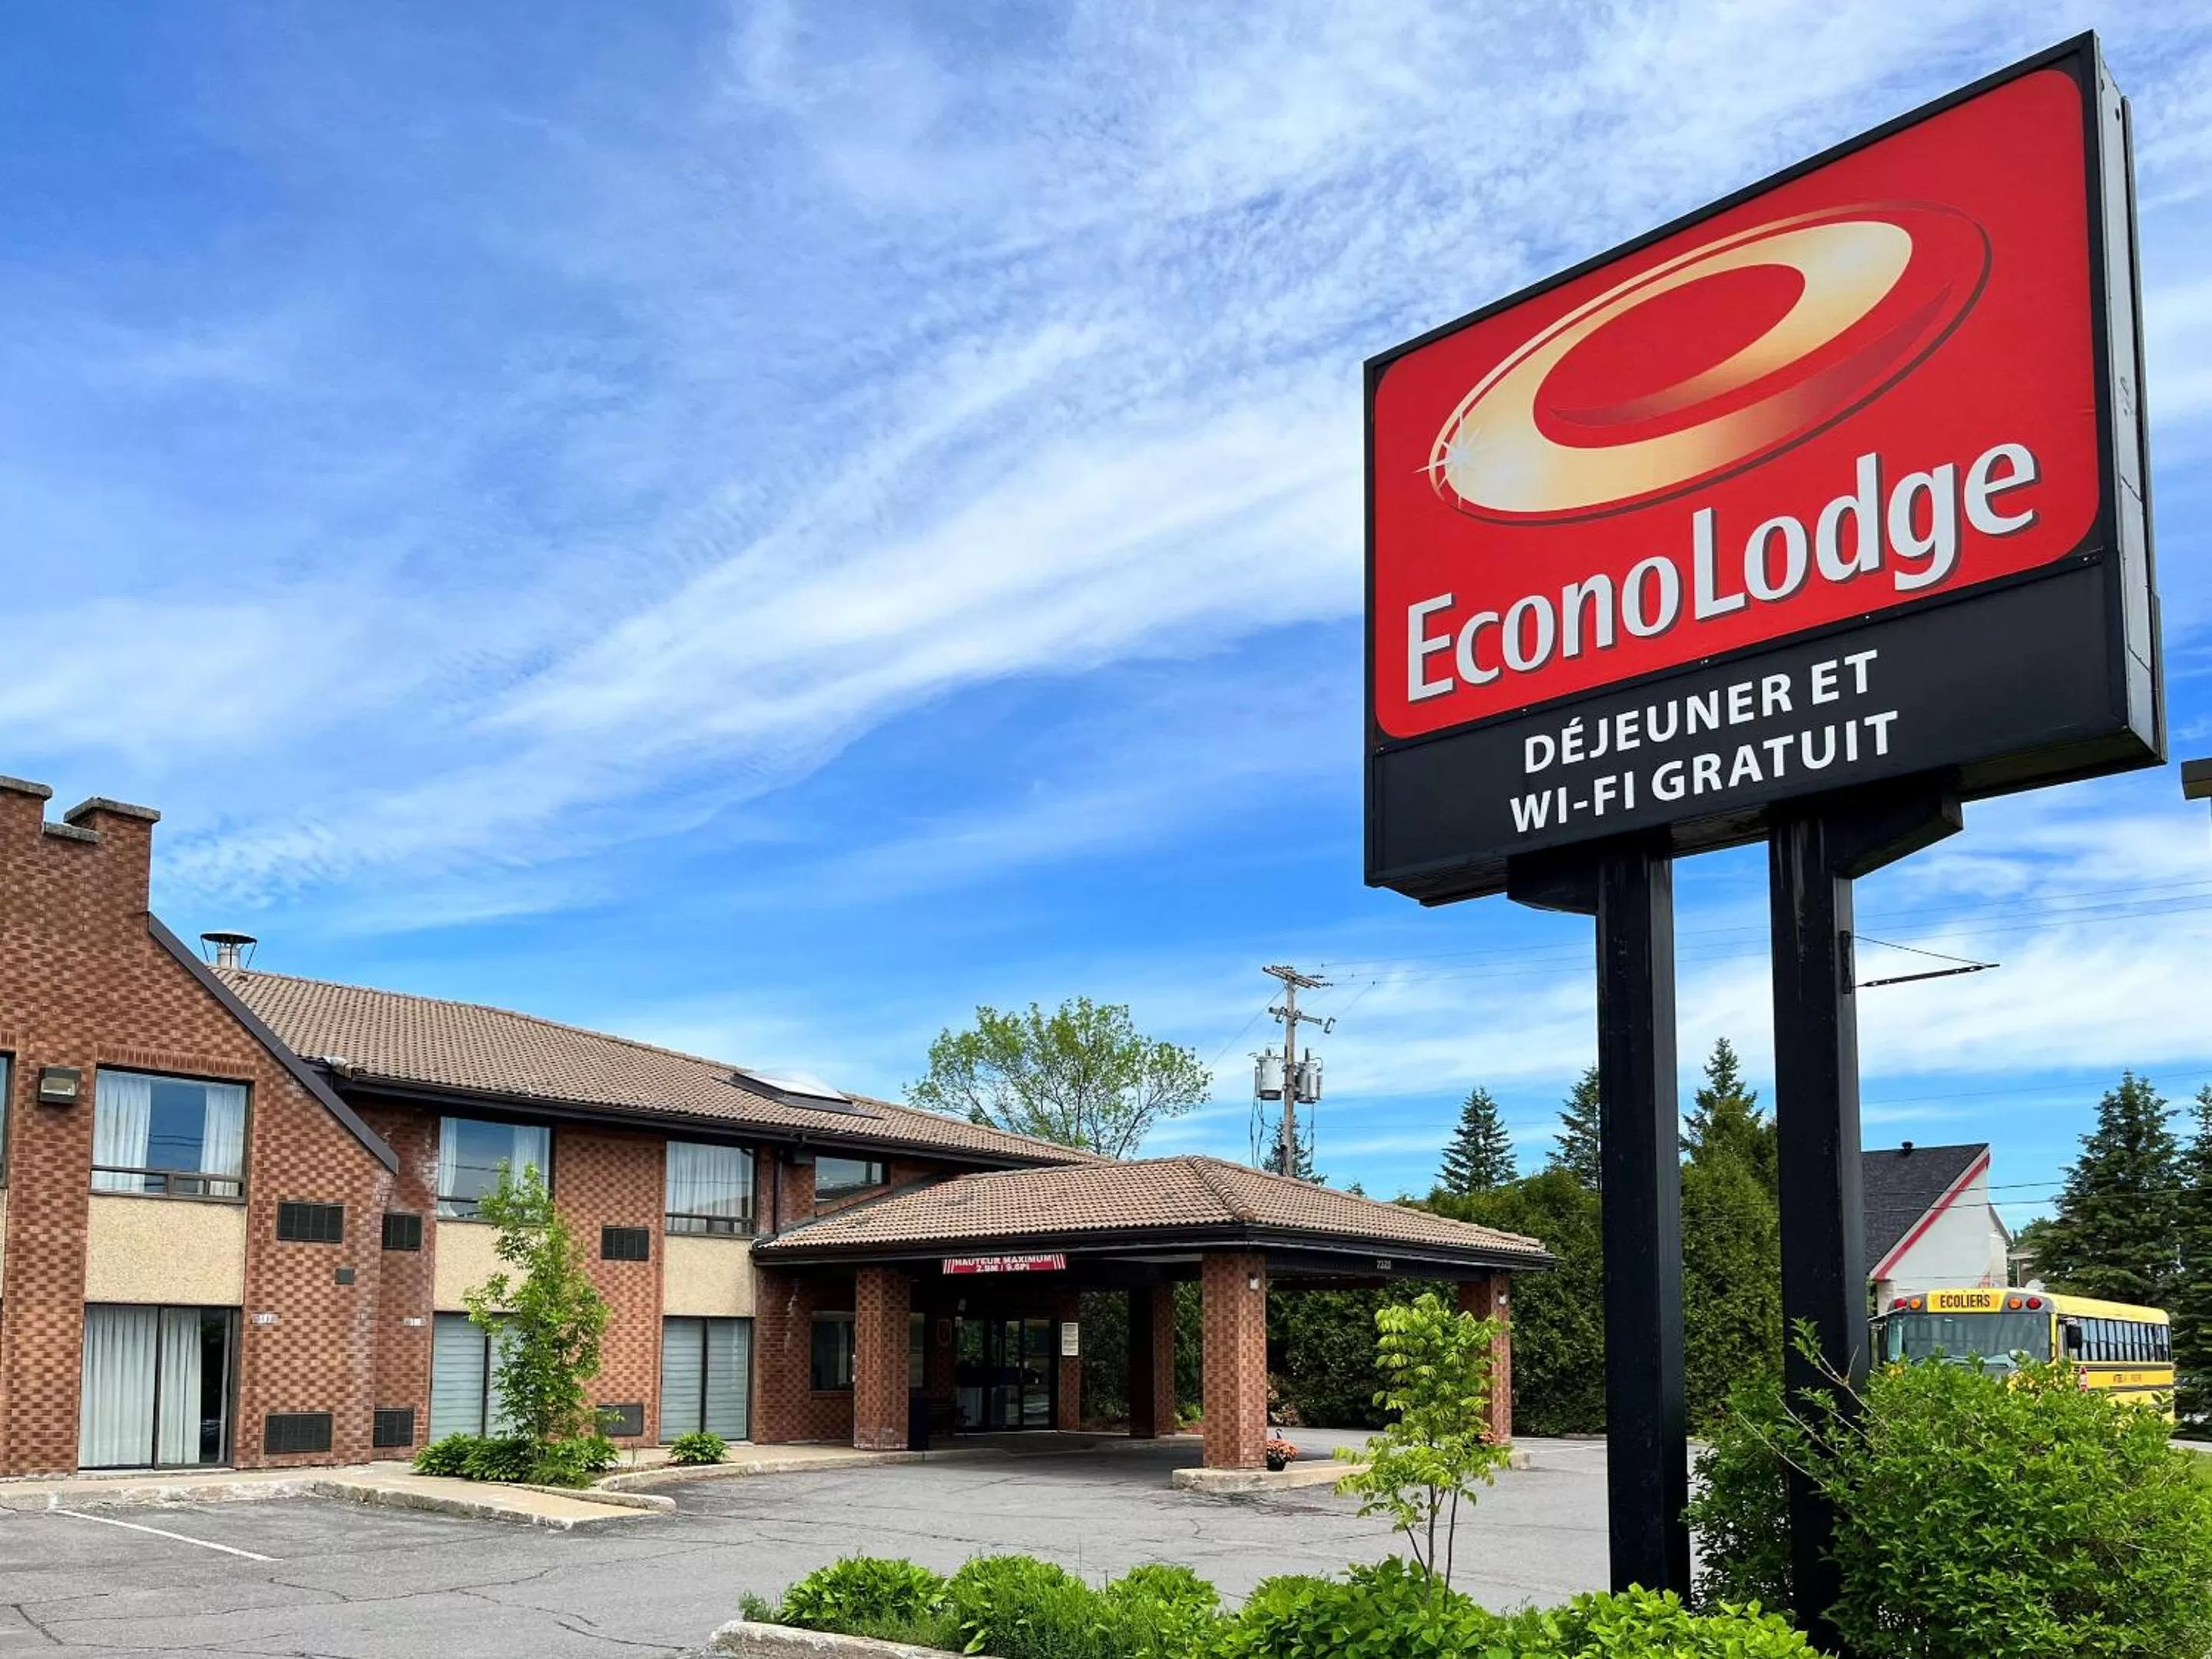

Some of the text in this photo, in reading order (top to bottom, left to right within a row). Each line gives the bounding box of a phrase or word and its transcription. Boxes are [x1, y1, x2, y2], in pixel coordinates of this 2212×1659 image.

[1407, 443, 2039, 703] EconoLodge
[1510, 710, 1899, 833] WI-FI GRATUIT
[1524, 649, 1878, 774] DÉJEUNER ET
[955, 1254, 1052, 1266] HAUTEUR MAXIMUM
[1940, 1294, 1990, 1308] ECOLIERS
